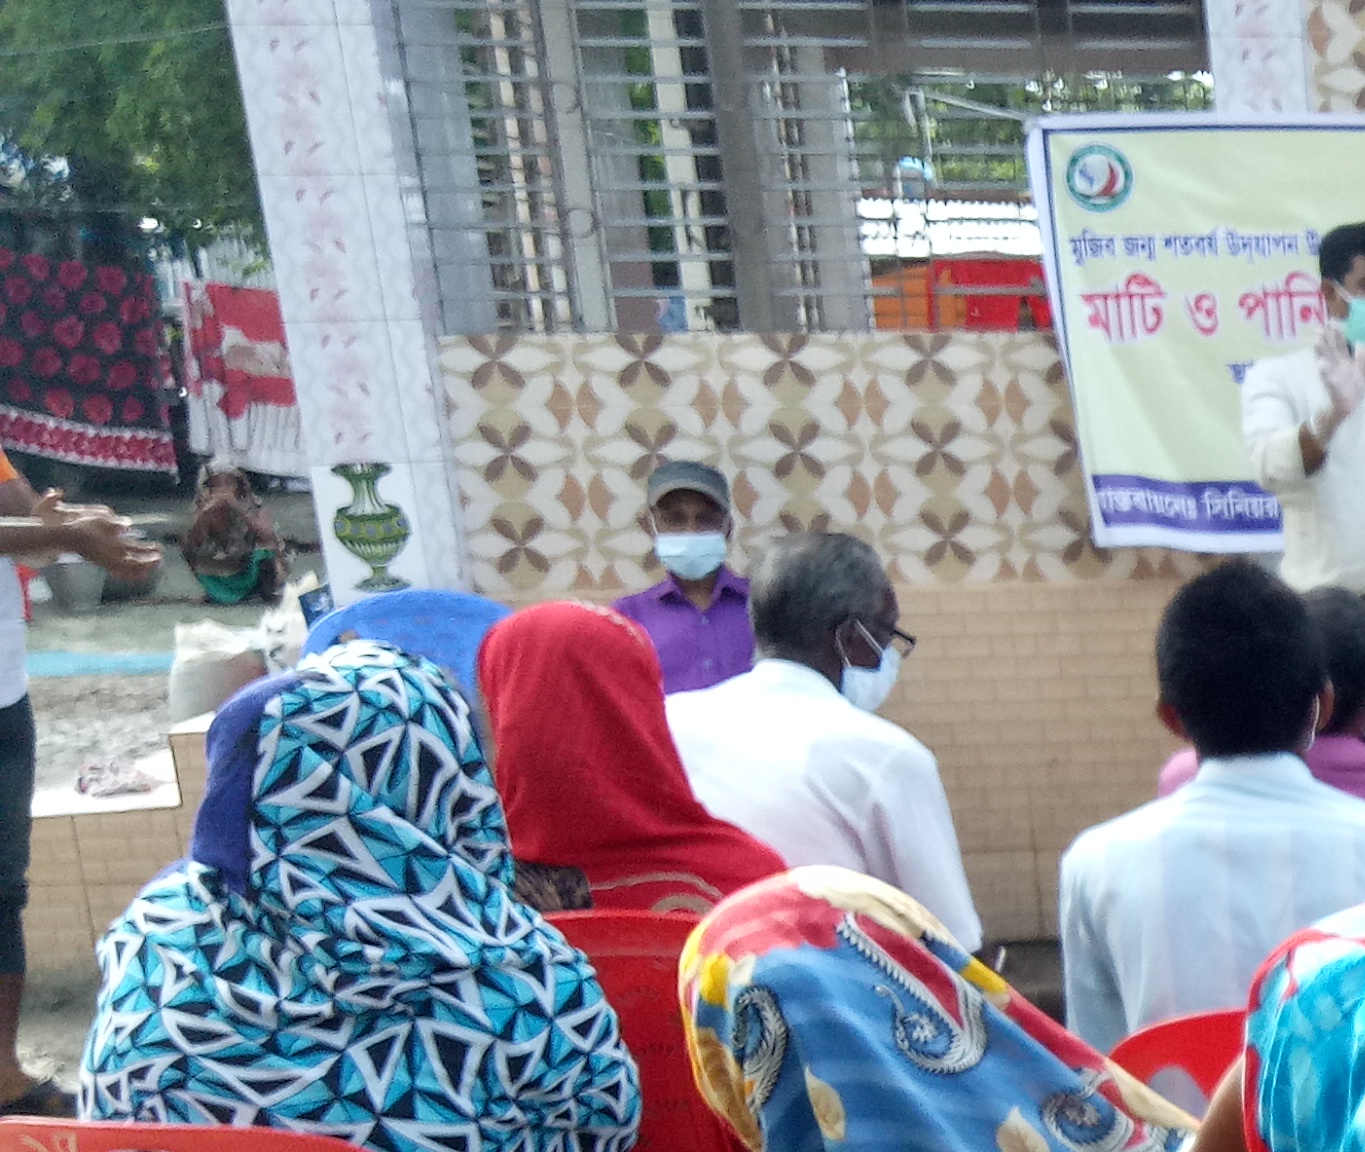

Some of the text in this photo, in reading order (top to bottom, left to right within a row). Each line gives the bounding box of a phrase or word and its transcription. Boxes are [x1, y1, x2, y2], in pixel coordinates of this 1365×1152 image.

[1080, 271, 1329, 340] মাটি ও পানি
